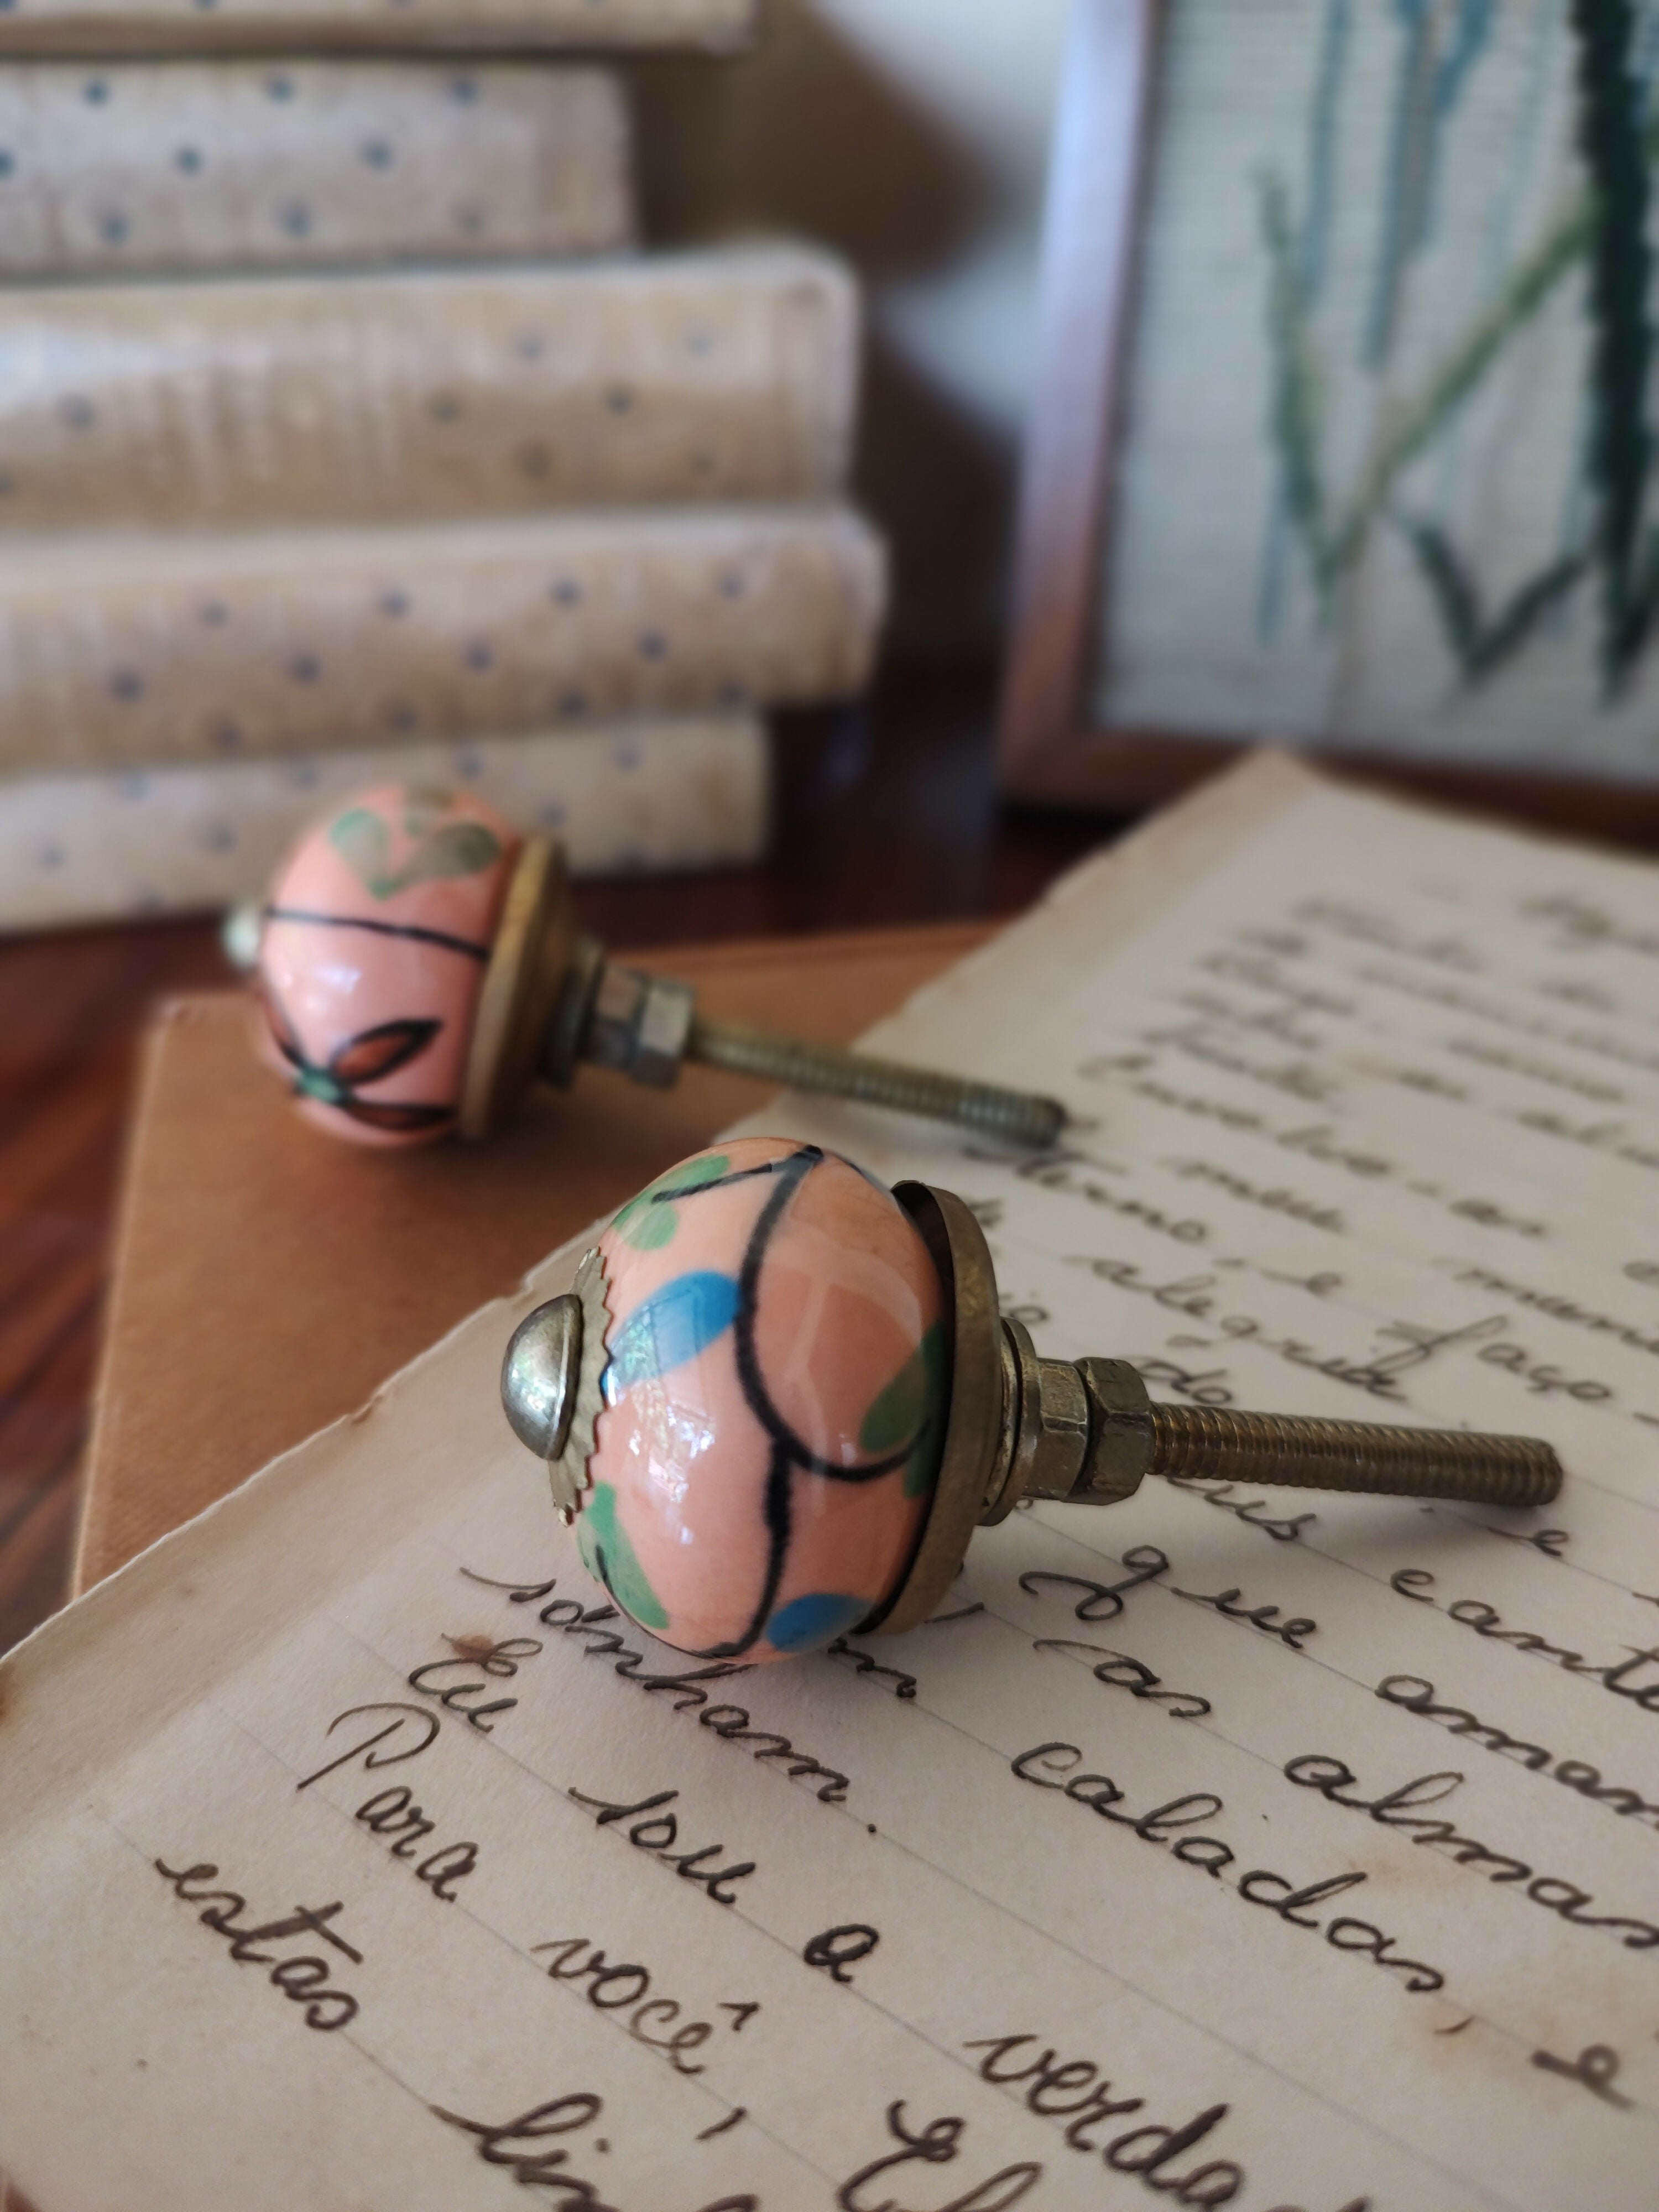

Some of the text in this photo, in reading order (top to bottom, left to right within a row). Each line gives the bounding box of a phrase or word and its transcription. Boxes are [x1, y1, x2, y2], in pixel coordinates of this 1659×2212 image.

[1019, 1545, 1316, 1649] que
[296, 1702, 480, 1902] Para
[408, 1631, 544, 1734] Eu
[567, 1789, 757, 1905] sou
[803, 1923, 880, 1984] a
[1032, 1638, 1211, 1717] as
[1283, 1754, 1659, 1949] almas
[154, 1857, 363, 2032] estas
